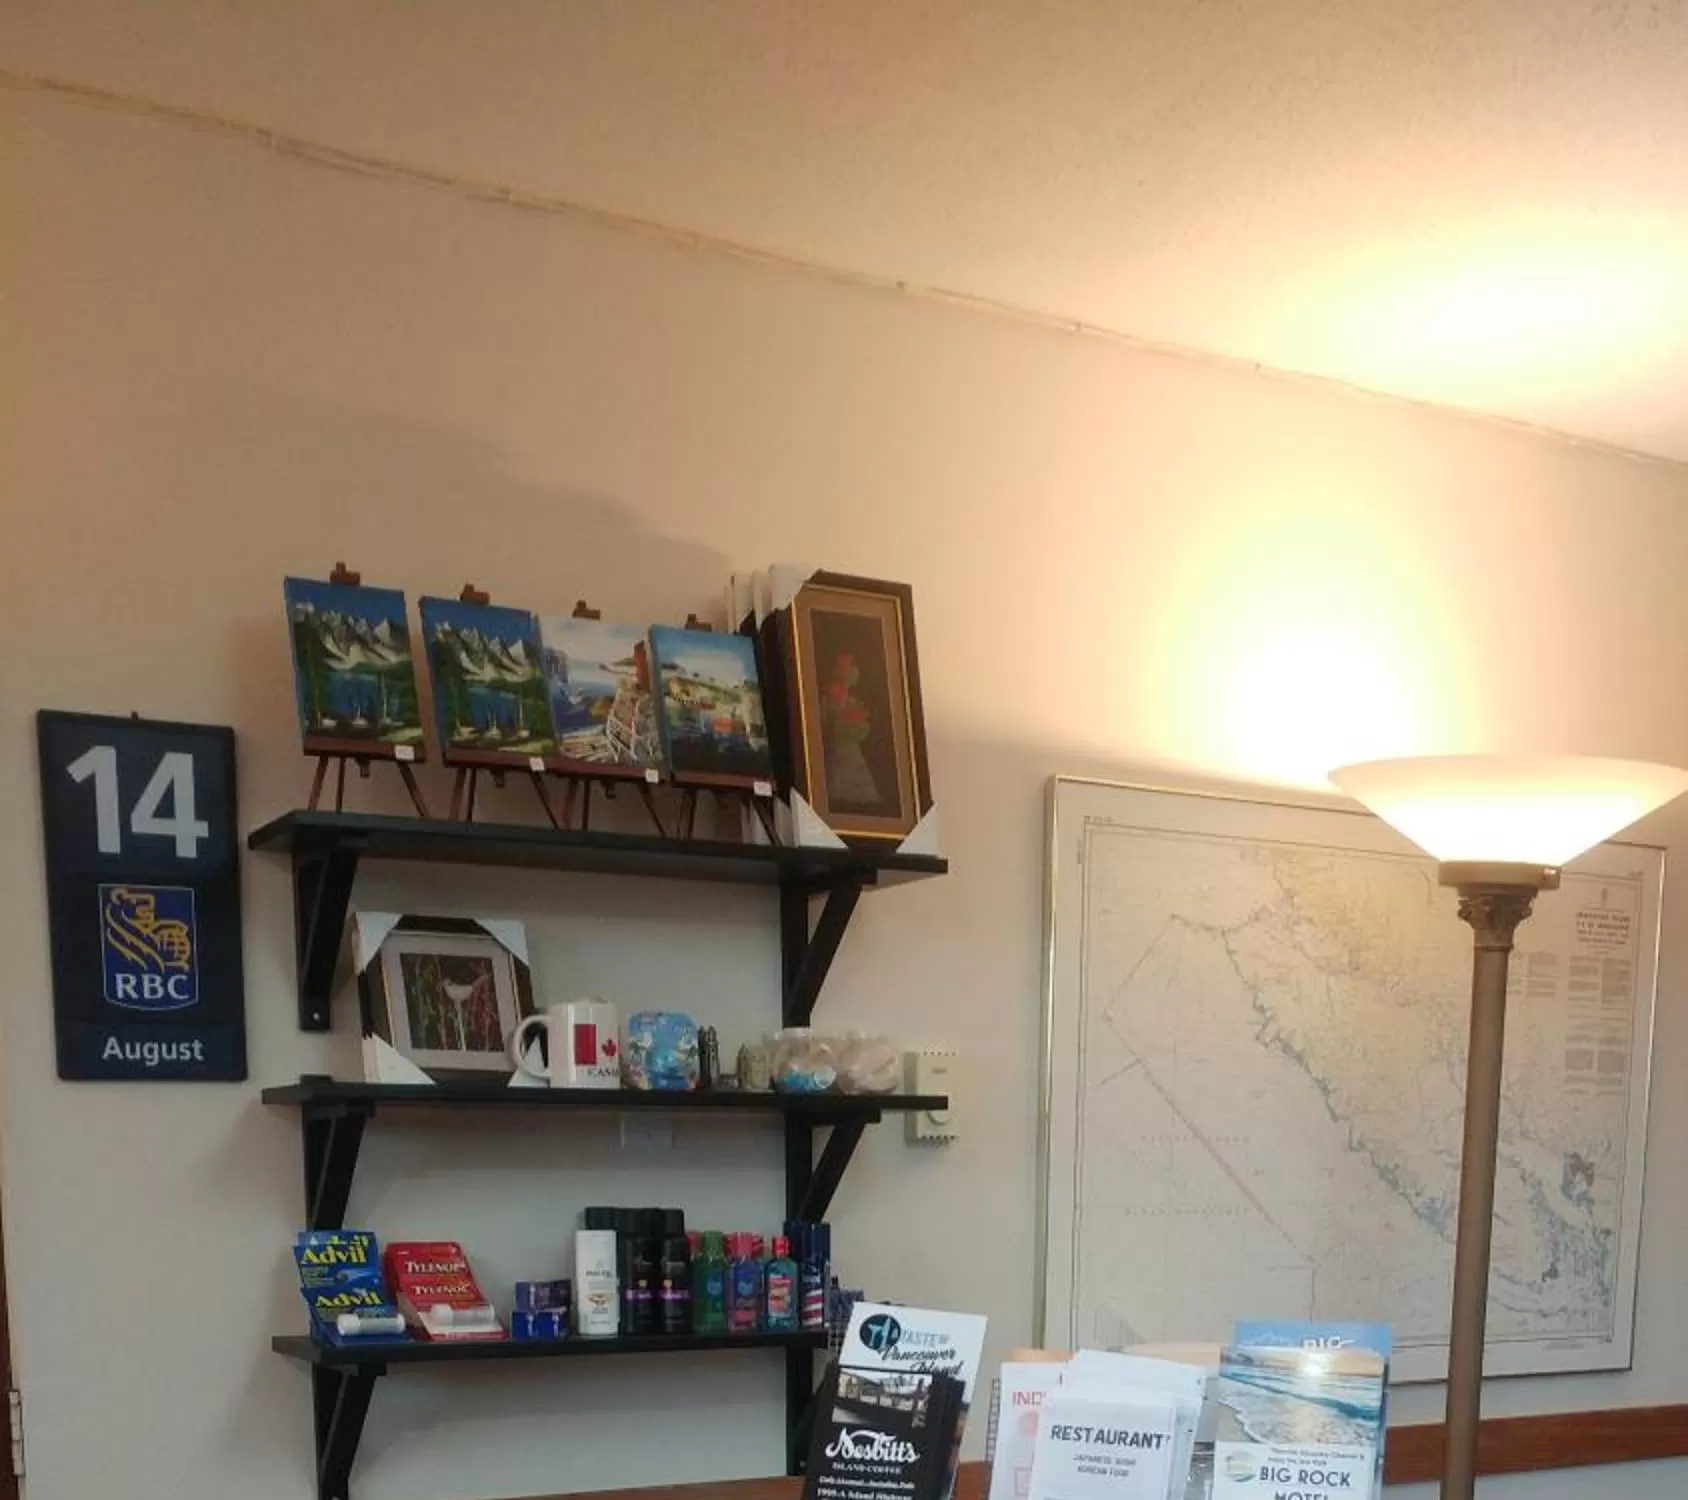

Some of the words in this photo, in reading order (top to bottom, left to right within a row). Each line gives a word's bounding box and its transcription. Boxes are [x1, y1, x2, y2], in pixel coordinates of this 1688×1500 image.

[65, 744, 209, 859] 14
[115, 973, 189, 1000] RBC
[102, 1036, 205, 1065] August
[301, 1246, 367, 1264] Advil
[316, 1290, 382, 1307] Advil
[1050, 1424, 1165, 1451] RESTAURANT
[1259, 1465, 1292, 1483] BIG
[1298, 1468, 1352, 1488] ROCK
